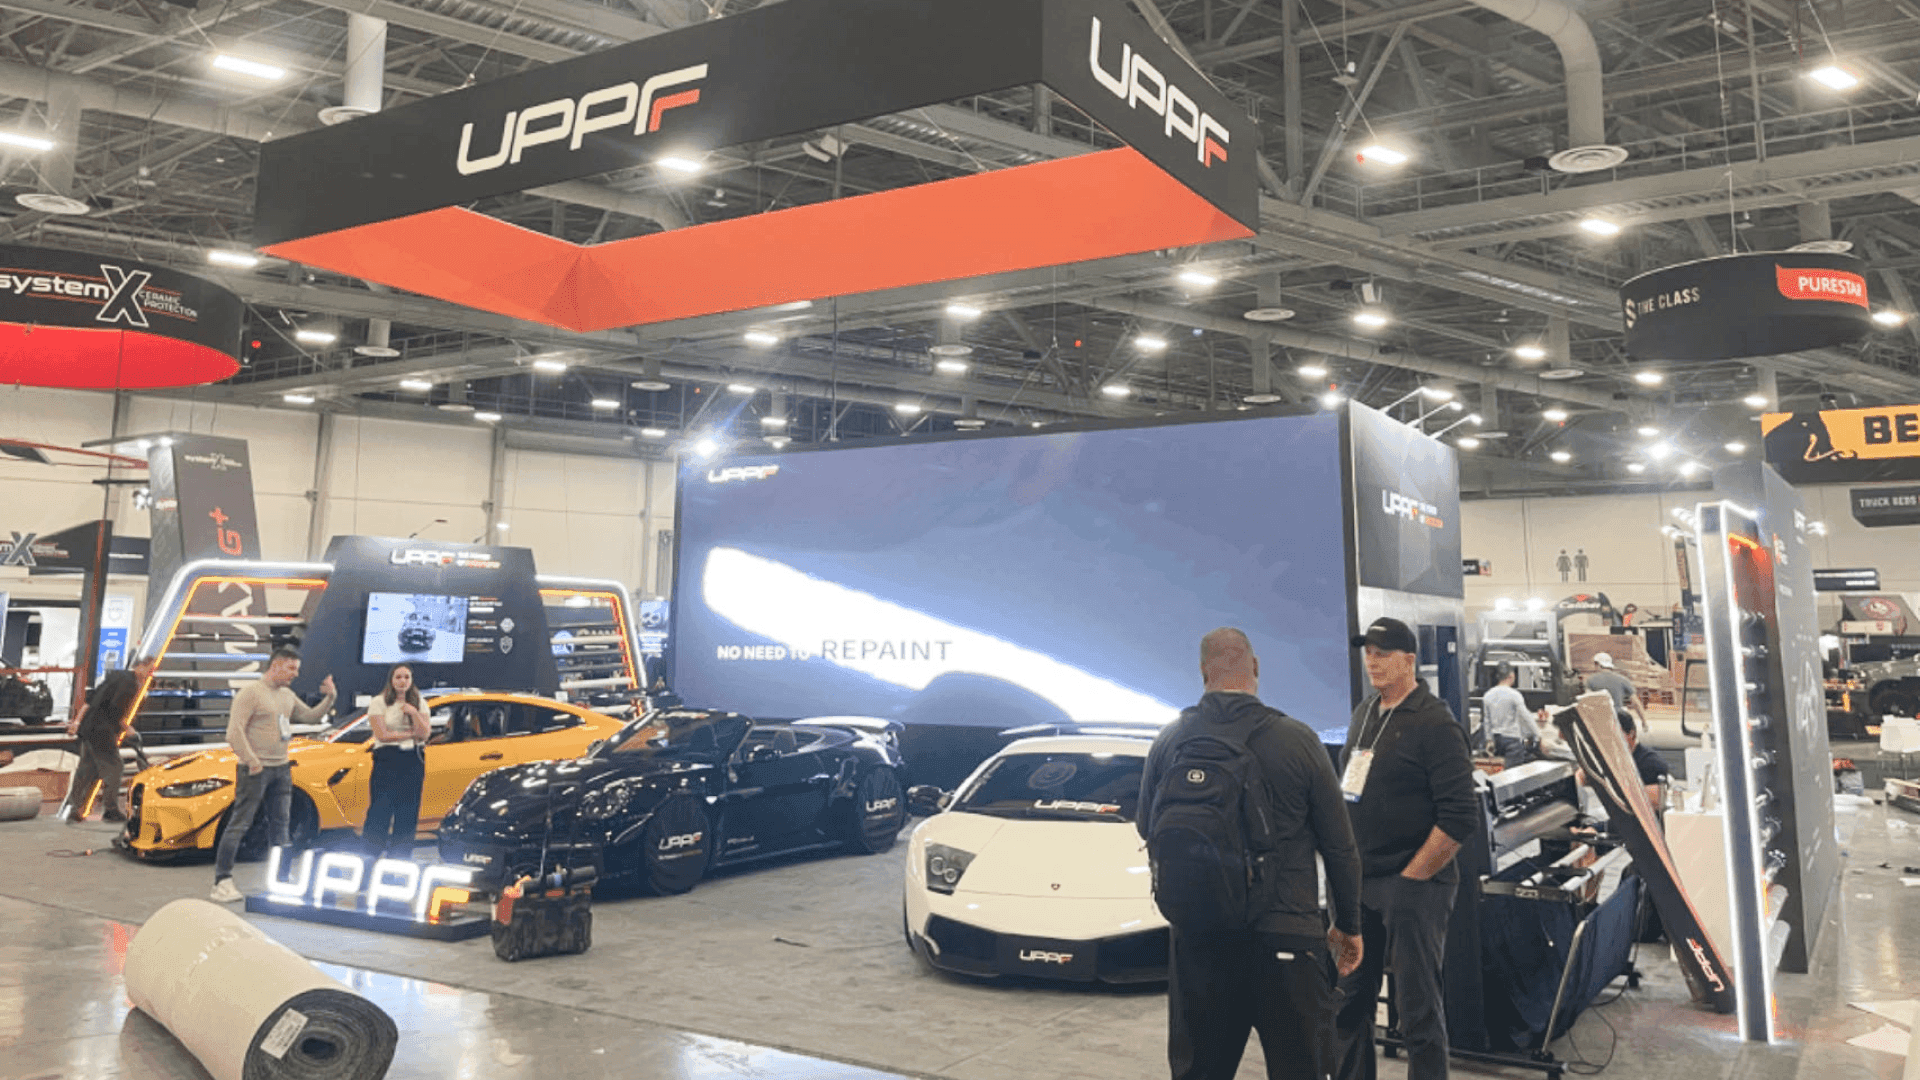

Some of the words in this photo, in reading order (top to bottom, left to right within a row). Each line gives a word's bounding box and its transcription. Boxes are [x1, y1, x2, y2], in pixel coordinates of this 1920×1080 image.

[1089, 16, 1230, 168] UPPF
[457, 63, 709, 176] UPPF
[1798, 276, 1862, 296] PURESTAR
[138, 290, 181, 304] CERAMIC
[1658, 287, 1701, 309] CLASS
[144, 300, 198, 317] PROTECTION
[708, 464, 780, 482] UPPF
[717, 644, 739, 660] NO
[743, 644, 787, 660] NEED
[789, 647, 811, 661] TO
[821, 640, 953, 660] REPAINT
[1034, 800, 1121, 814] UPPF
[659, 832, 703, 850] UPPF
[266, 845, 473, 924] UPPF
[1019, 949, 1073, 964] UPPF
